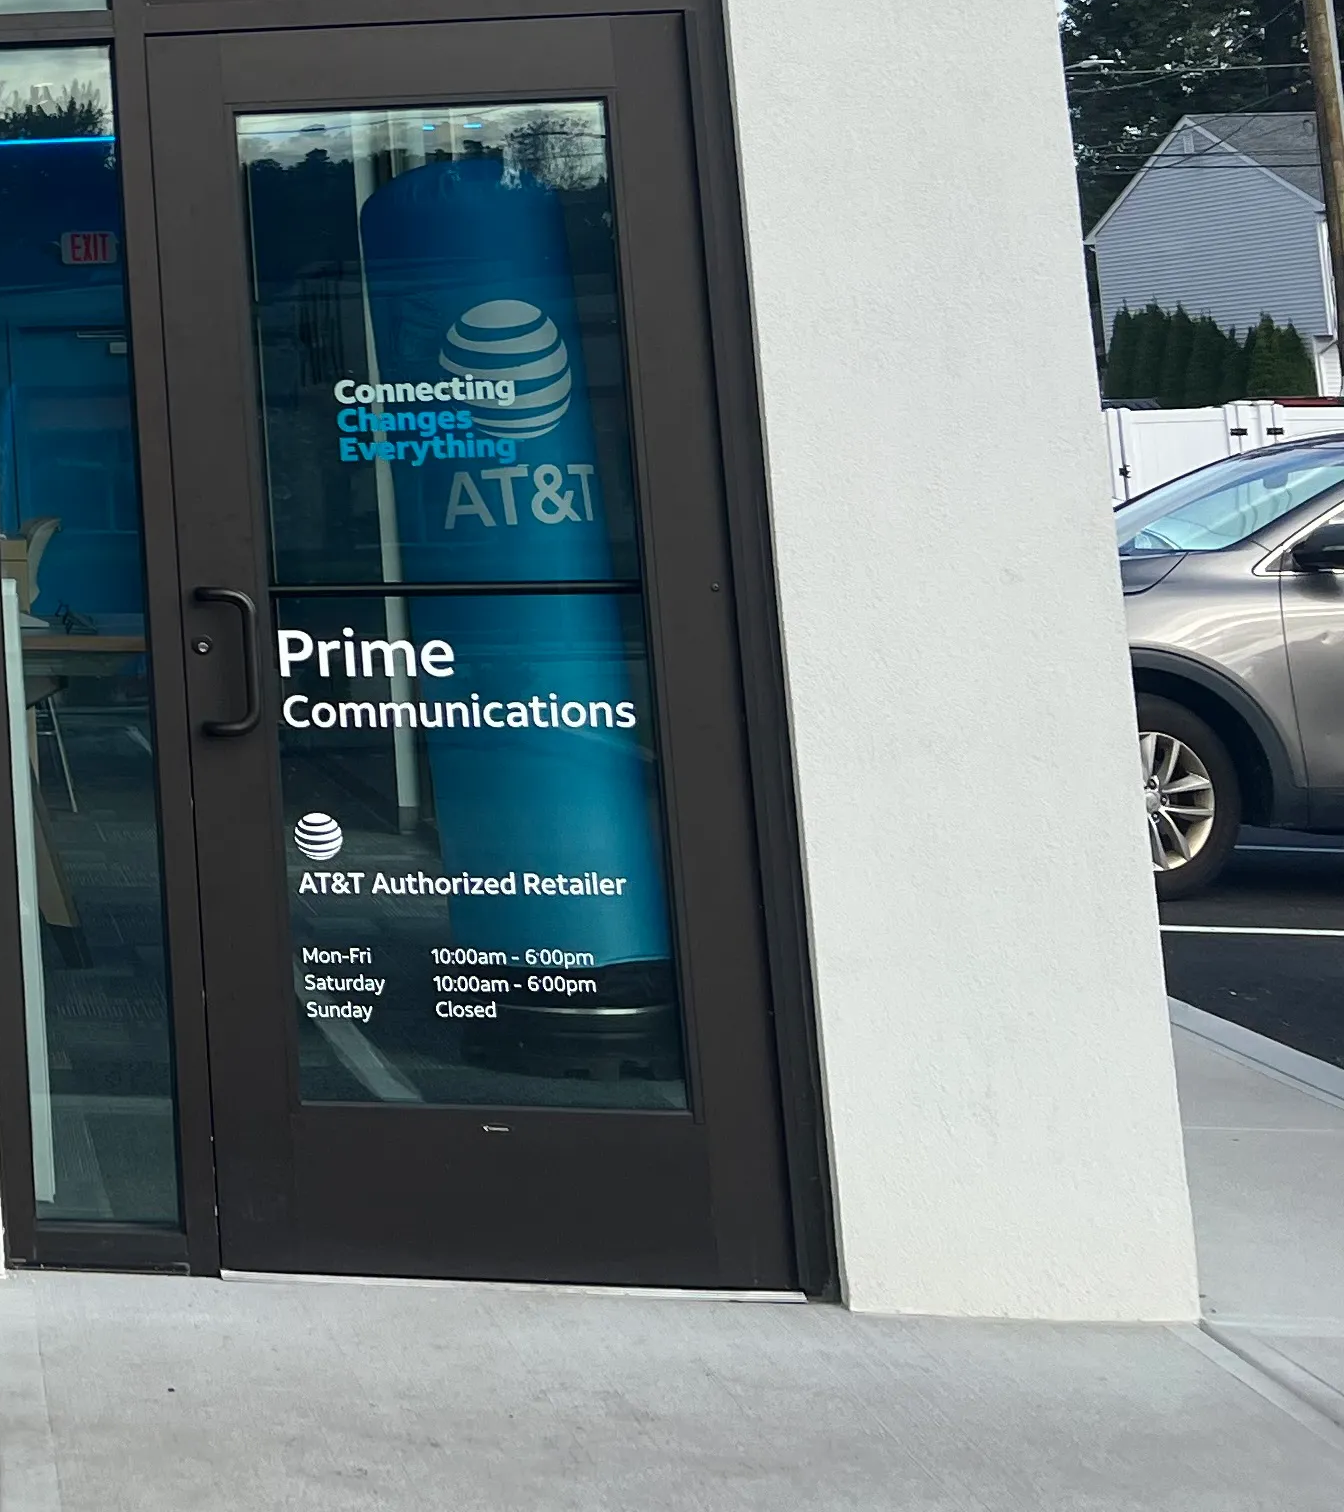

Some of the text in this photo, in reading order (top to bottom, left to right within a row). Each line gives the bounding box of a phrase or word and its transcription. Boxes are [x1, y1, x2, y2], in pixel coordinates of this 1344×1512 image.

[70, 233, 110, 262] EXIT
[334, 374, 516, 406] Connecting
[337, 407, 473, 437] Changes
[339, 436, 517, 466] Everything
[444, 463, 594, 530] AT&T
[277, 627, 455, 678] Prime
[283, 693, 636, 728] Communications
[298, 872, 626, 896] AT&T Authorized Retailer
[302, 947, 372, 965] Mon-Fri
[431, 948, 507, 966] 10:00am
[524, 949, 594, 970] 6:00pm
[304, 974, 385, 996] Saturday
[433, 975, 509, 993] 10:00am
[527, 976, 597, 997] 6:00pm
[306, 1001, 497, 1022] Sunday Closed
